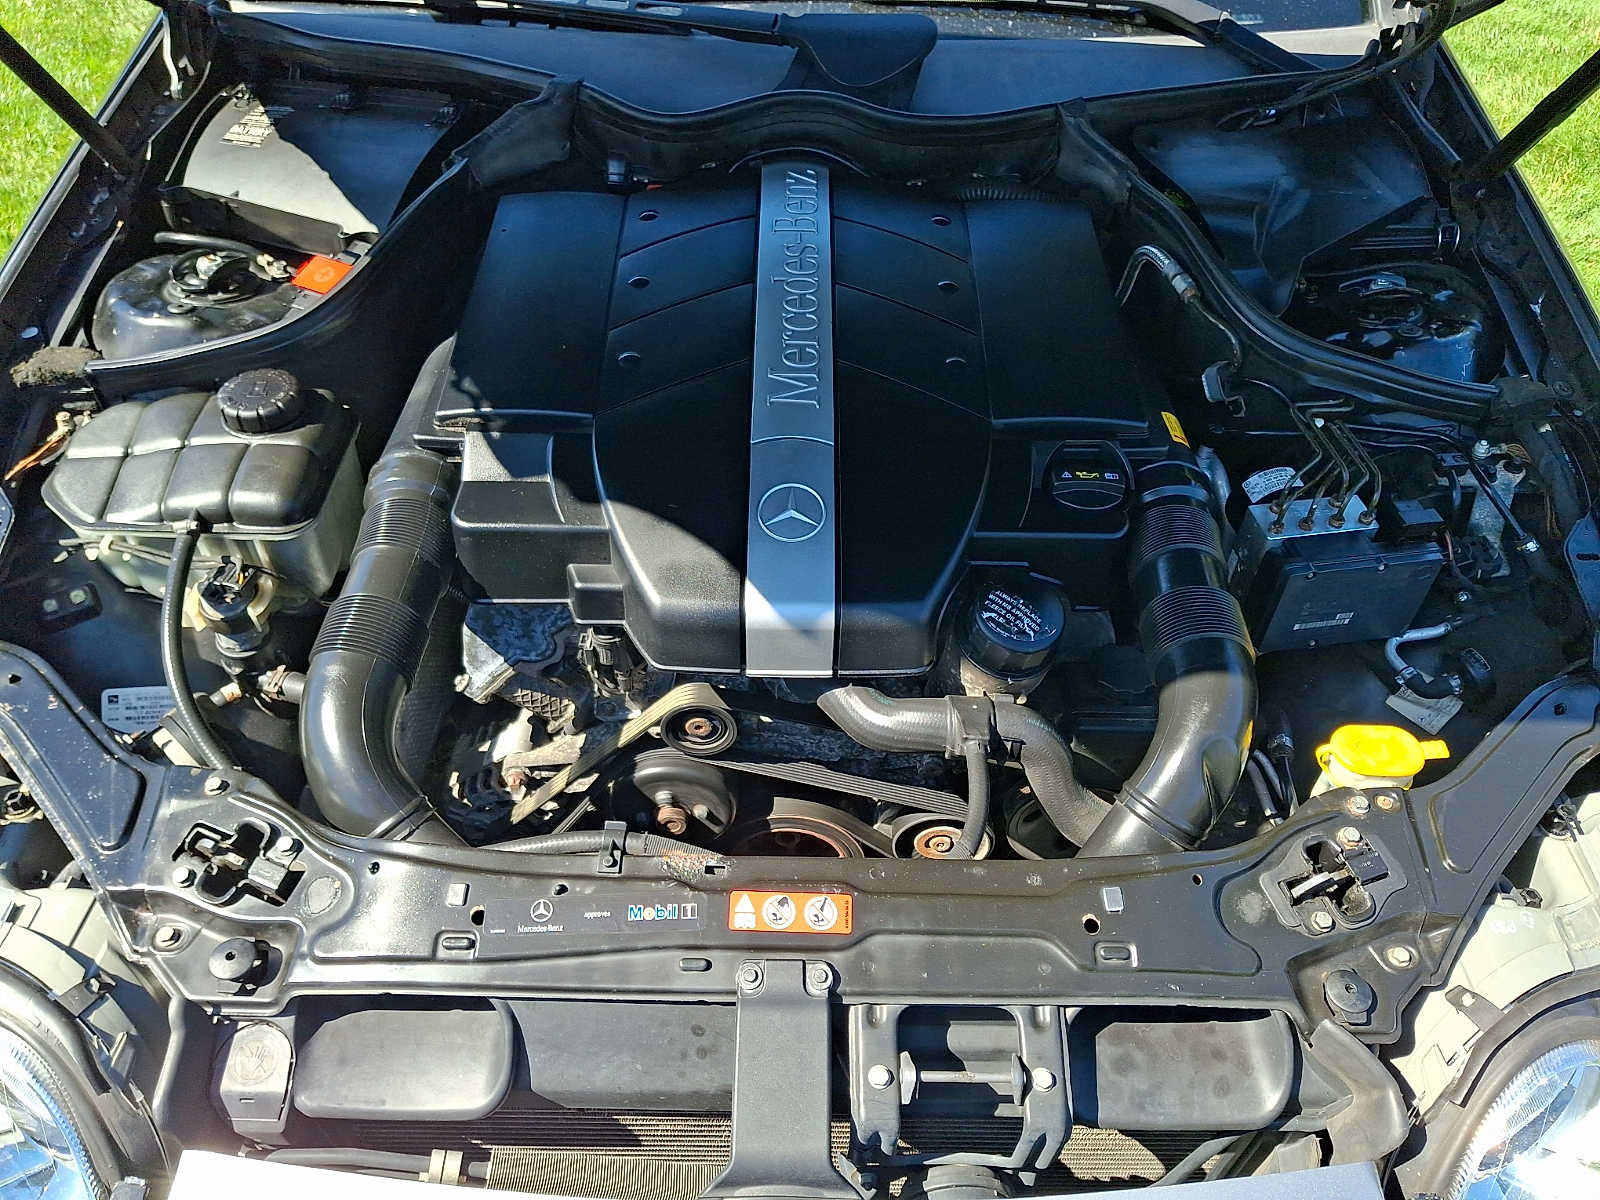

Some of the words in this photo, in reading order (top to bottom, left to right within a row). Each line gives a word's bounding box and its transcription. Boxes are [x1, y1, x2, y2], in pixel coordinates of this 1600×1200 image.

[767, 168, 819, 408] Mercedes-Benz
[988, 593, 1003, 605] WITH
[1011, 608, 1040, 631] APPROVED
[995, 590, 1018, 606] ALWAYS
[1017, 603, 1042, 624] REPLACE
[1006, 613, 1016, 623] OIL
[628, 903, 678, 921] Mobil
